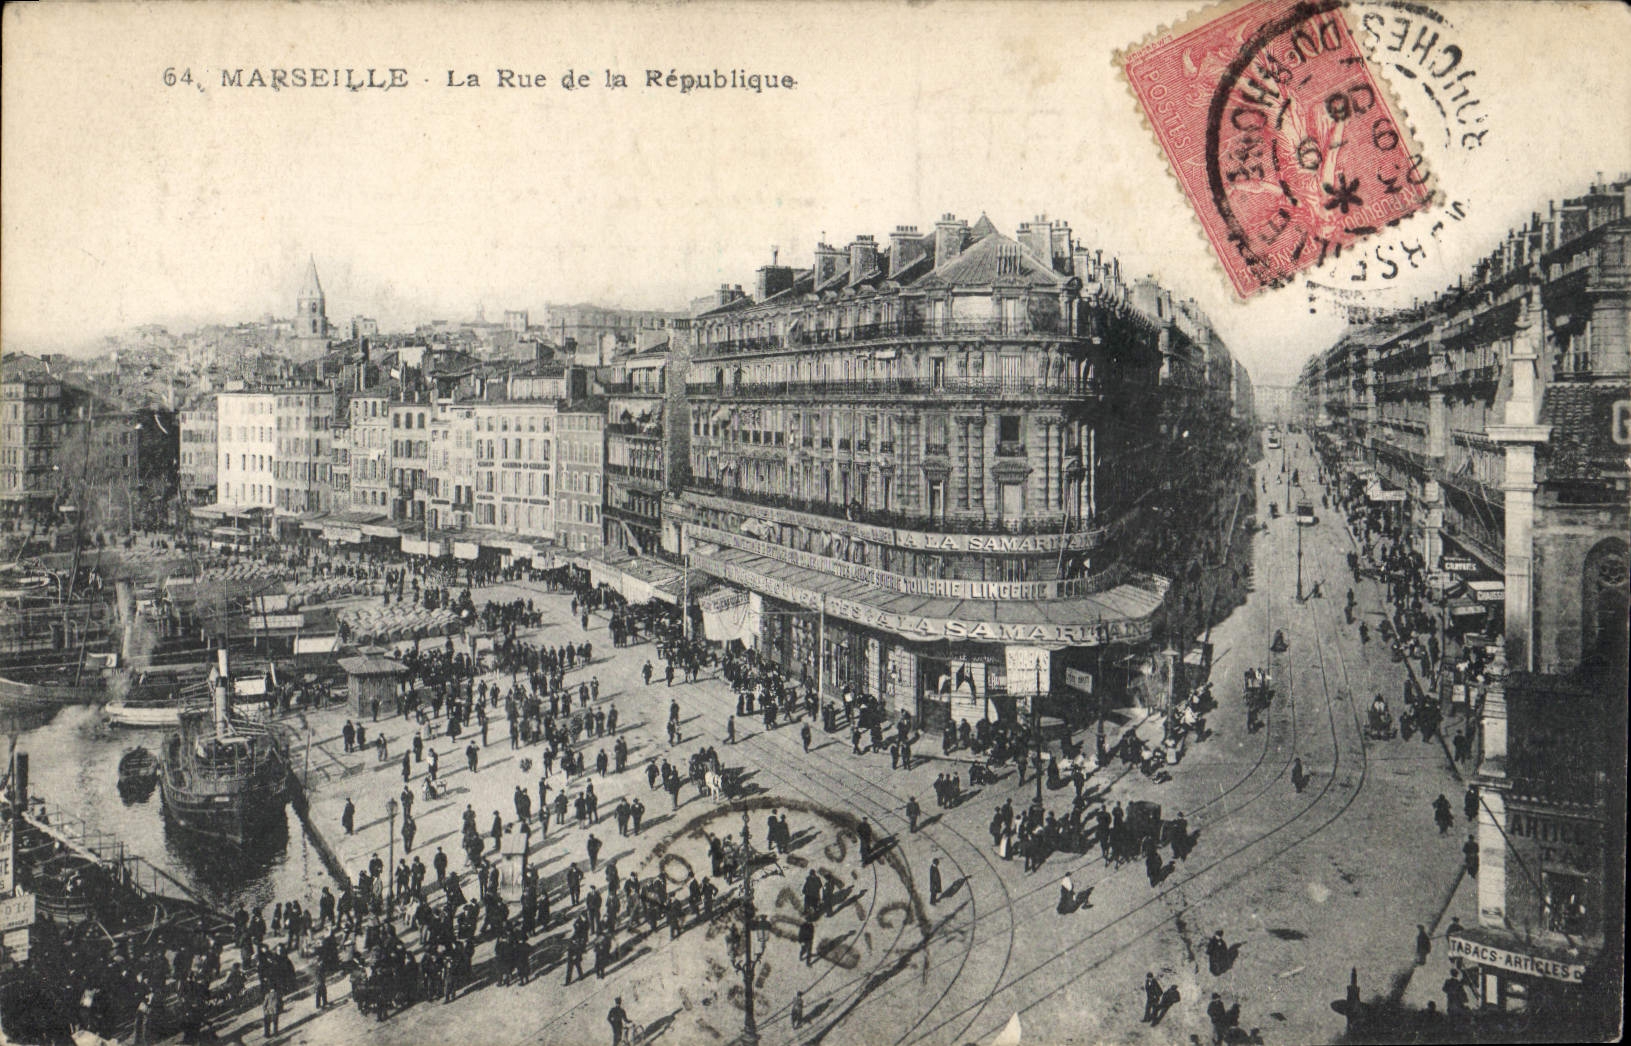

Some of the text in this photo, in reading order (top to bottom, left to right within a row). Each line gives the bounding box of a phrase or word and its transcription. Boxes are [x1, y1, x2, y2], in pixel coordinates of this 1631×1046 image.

[1142, 68, 1192, 150] POSTES
[925, 536, 960, 551] LA
[971, 582, 1048, 599] LINGERIE
